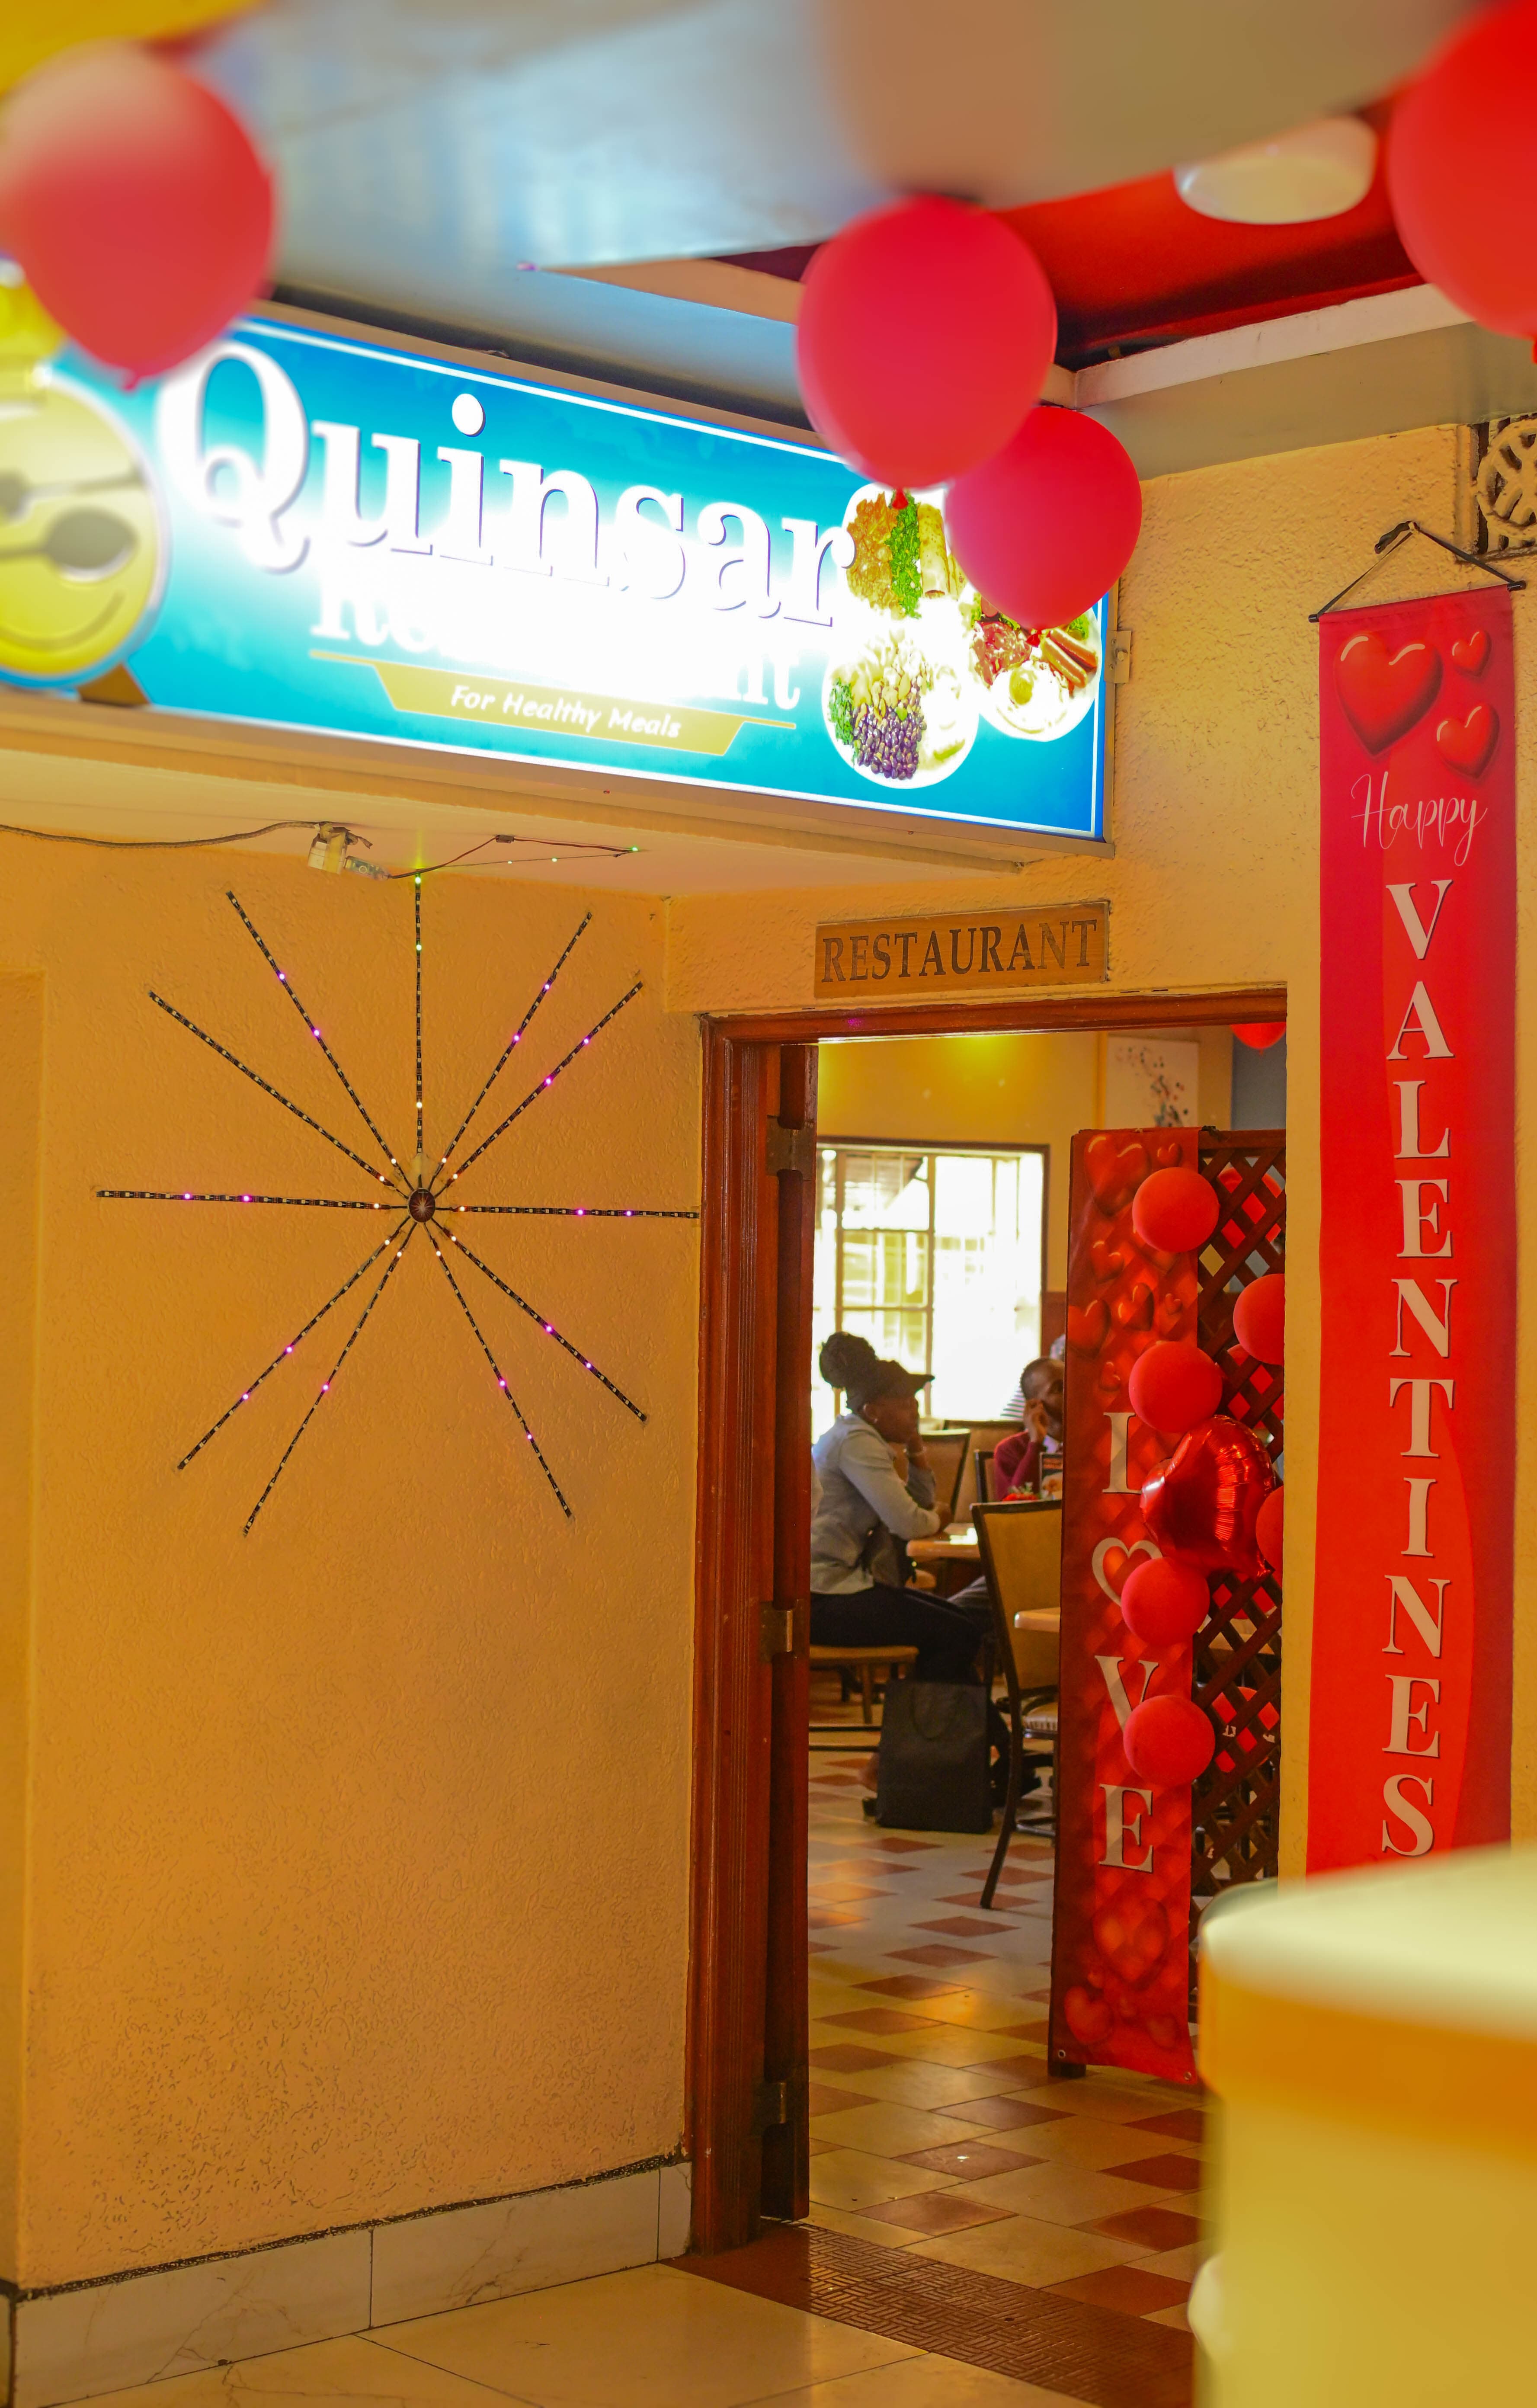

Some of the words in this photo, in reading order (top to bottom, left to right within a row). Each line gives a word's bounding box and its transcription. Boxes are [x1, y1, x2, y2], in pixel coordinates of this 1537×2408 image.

[158, 342, 856, 627] Quinsar
[451, 685, 496, 710] For
[503, 692, 602, 733] Healthy
[608, 707, 682, 738] Meals
[1351, 771, 1488, 866] Happy
[821, 919, 1097, 983] RESTAURANT
[1382, 879, 1457, 1857] VALENTINES
